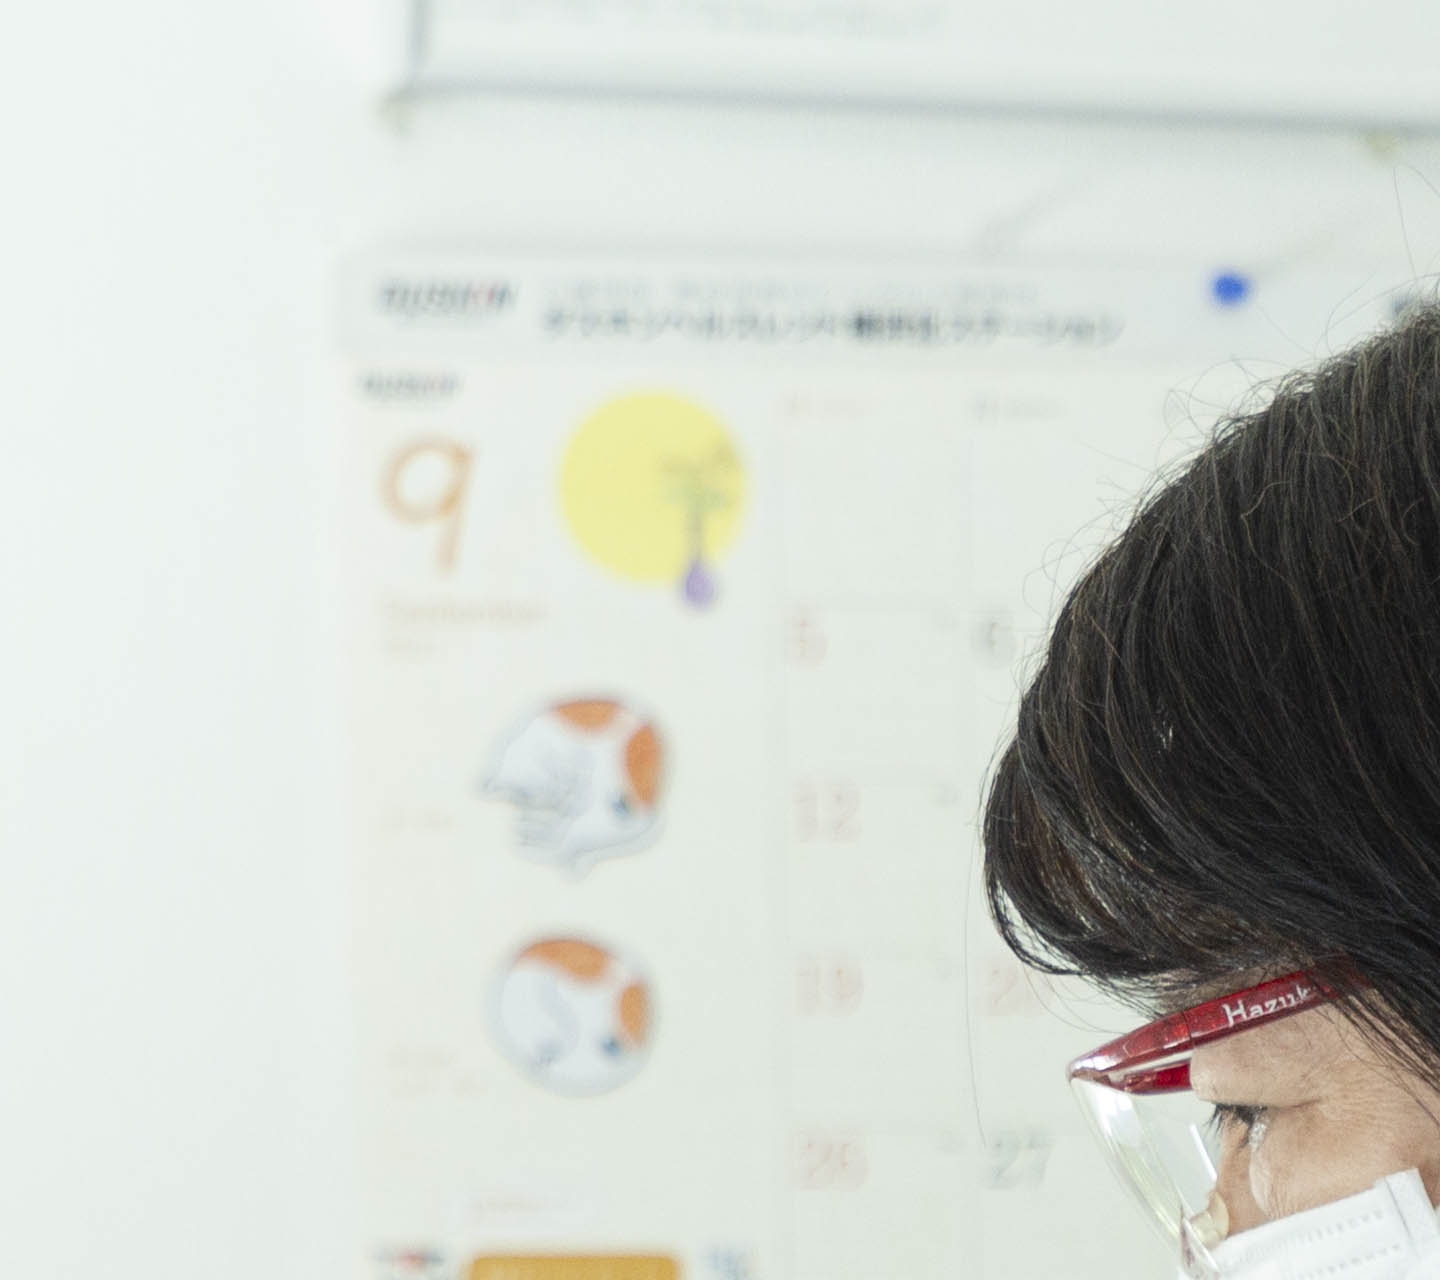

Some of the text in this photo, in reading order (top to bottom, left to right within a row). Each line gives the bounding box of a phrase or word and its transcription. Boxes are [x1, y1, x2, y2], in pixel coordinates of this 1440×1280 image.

[379, 433, 476, 575] 9
[792, 777, 862, 843] 12
[982, 1127, 1052, 1189] 27
